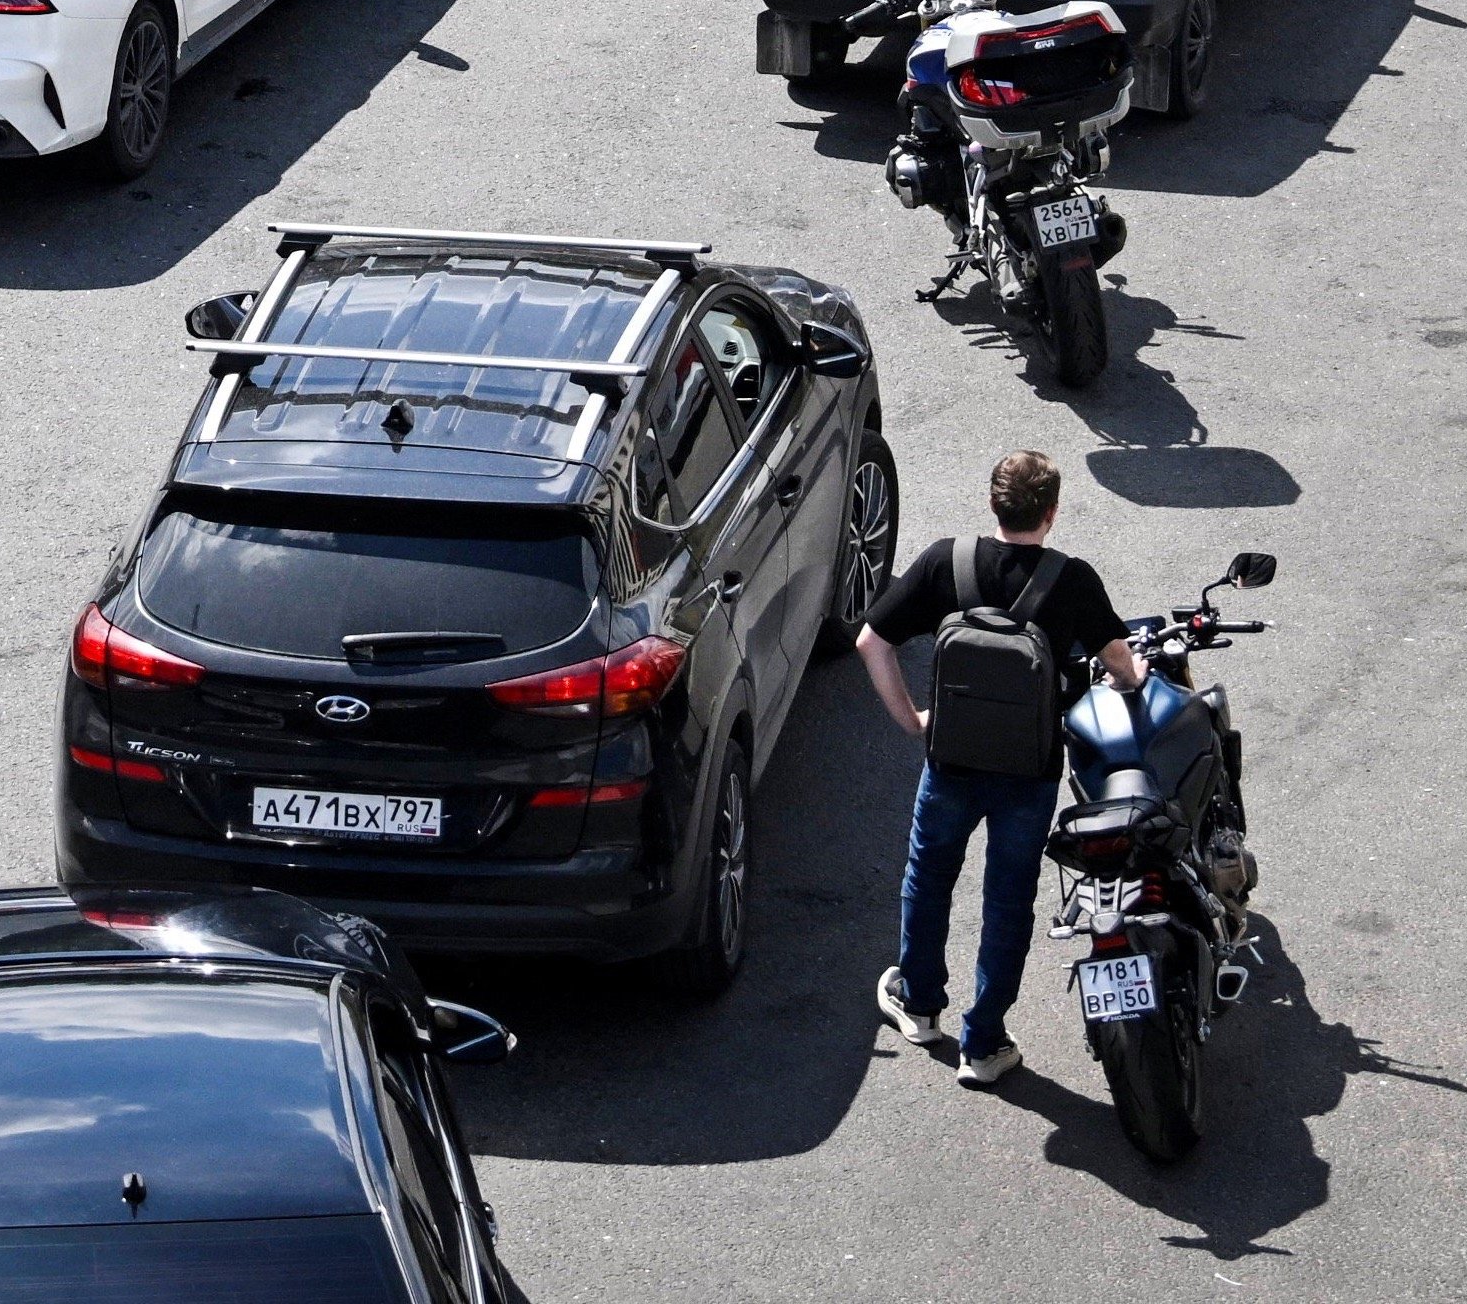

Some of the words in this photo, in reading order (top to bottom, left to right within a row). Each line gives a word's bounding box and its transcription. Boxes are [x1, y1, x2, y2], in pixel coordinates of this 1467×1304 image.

[1040, 202, 1084, 222] 2564
[1041, 226, 1067, 246] ХВ
[1070, 221, 1092, 238] 77
[126, 740, 201, 762] TUCSON
[263, 794, 381, 828] А471ВХ
[387, 798, 432, 824] 797
[397, 822, 419, 832] RUS
[1087, 959, 1141, 984] 7181
[1117, 980, 1135, 988] RUS
[1086, 992, 1116, 1014] ВР
[1125, 987, 1151, 1009] 50
[1110, 1012, 1141, 1022] HONDA
